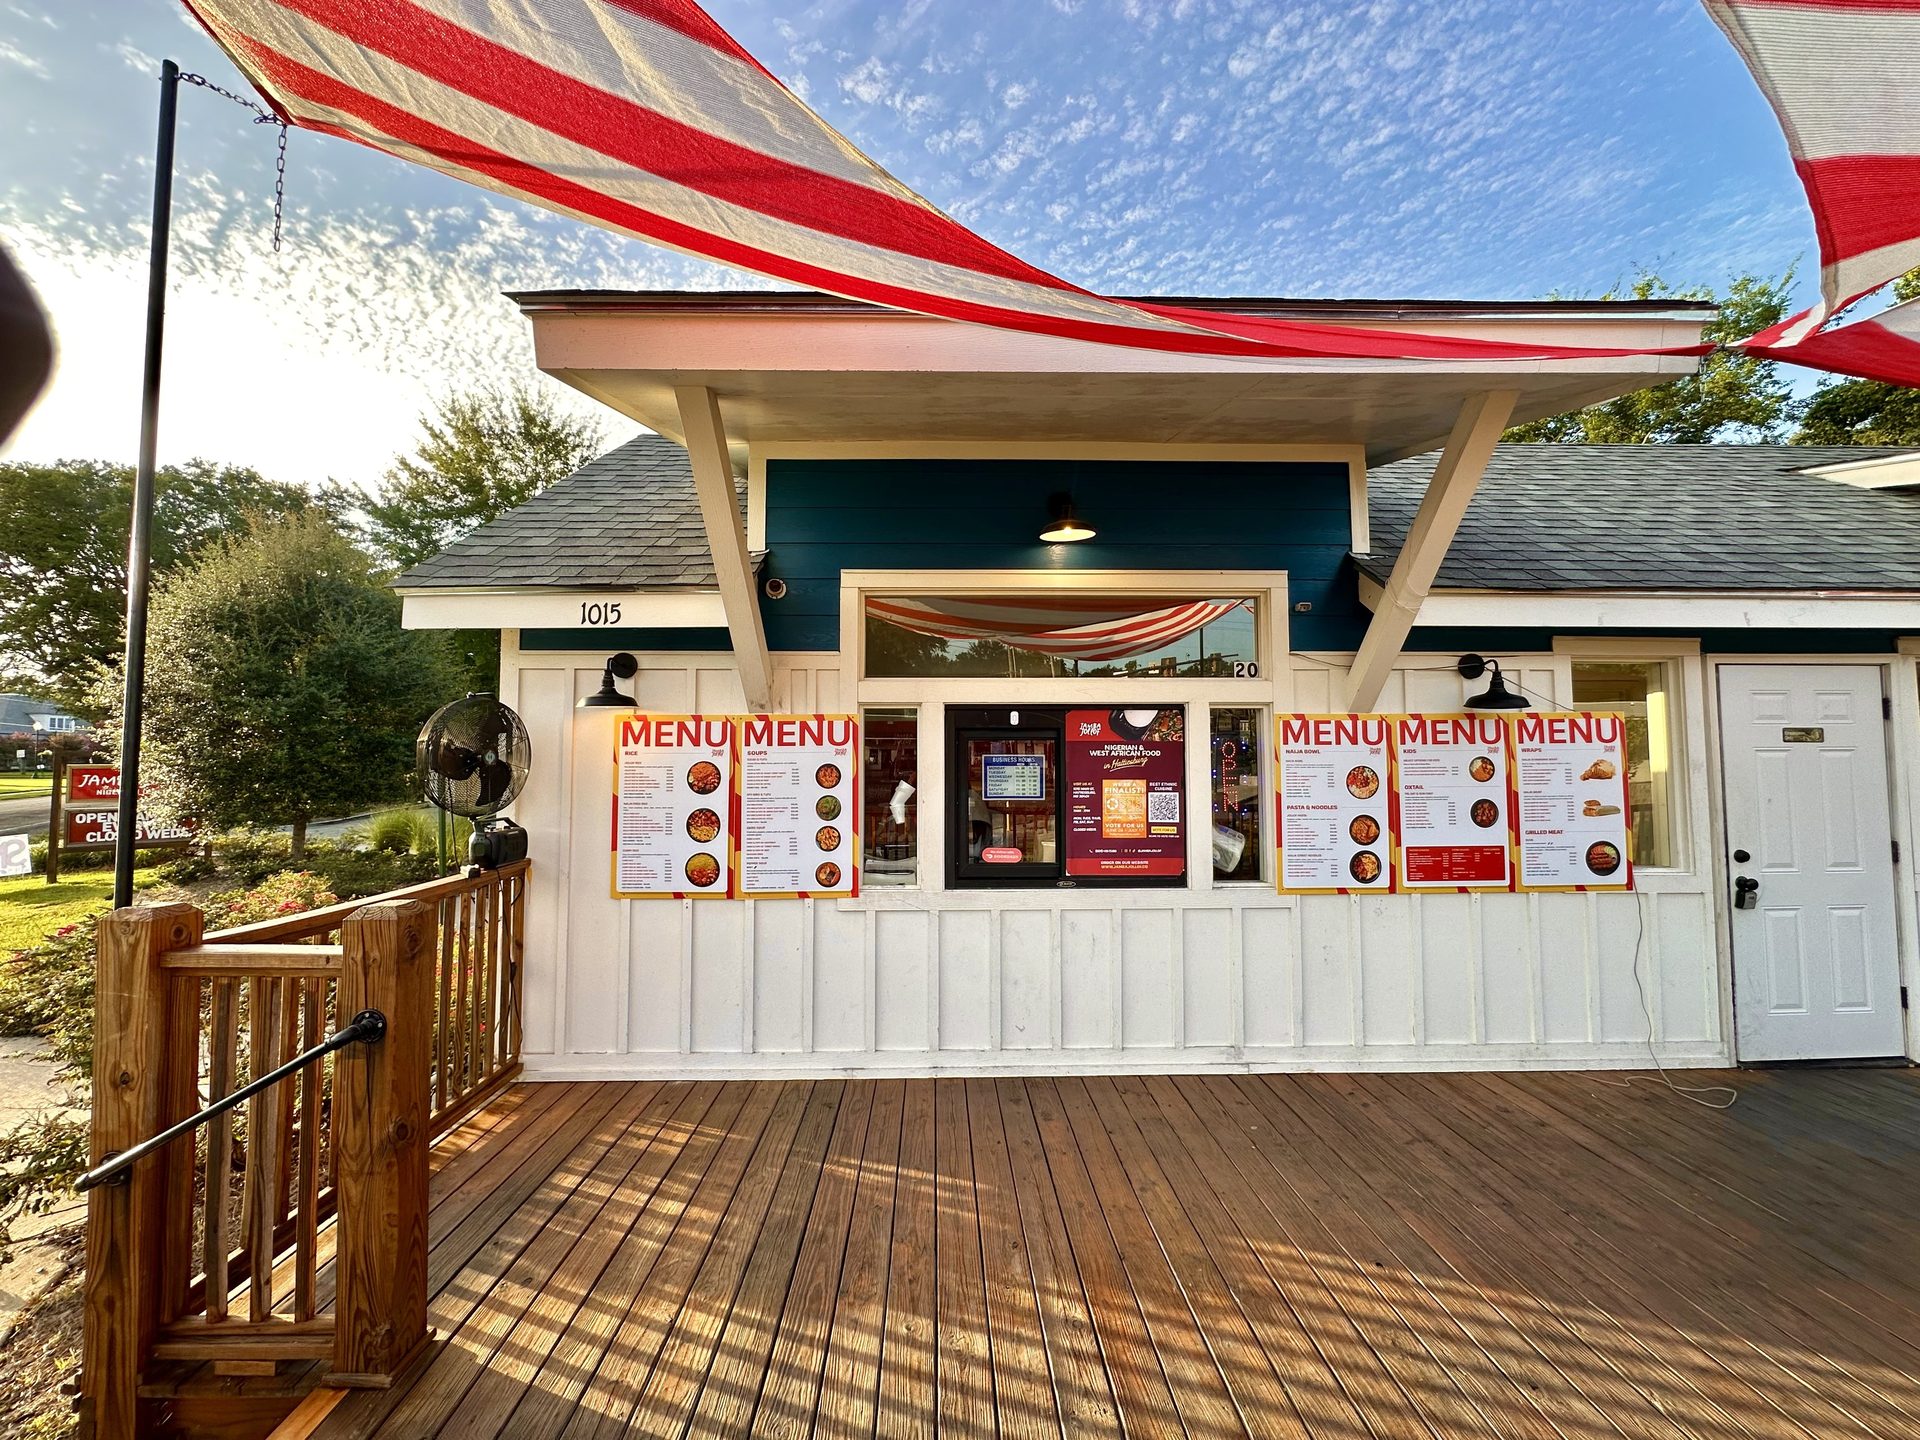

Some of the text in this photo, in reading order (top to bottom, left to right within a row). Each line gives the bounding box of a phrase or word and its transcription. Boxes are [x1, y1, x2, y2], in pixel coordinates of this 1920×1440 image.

[580, 602, 622, 625] 1015
[1235, 662, 1258, 678] 20
[622, 721, 728, 747] MENU
[744, 720, 851, 747] MENU
[1282, 719, 1384, 746] MENU
[1400, 719, 1501, 745] MENU
[1517, 718, 1618, 744] MENU
[1221, 741, 1239, 812] OPEN
[75, 812, 118, 824] OPEN
